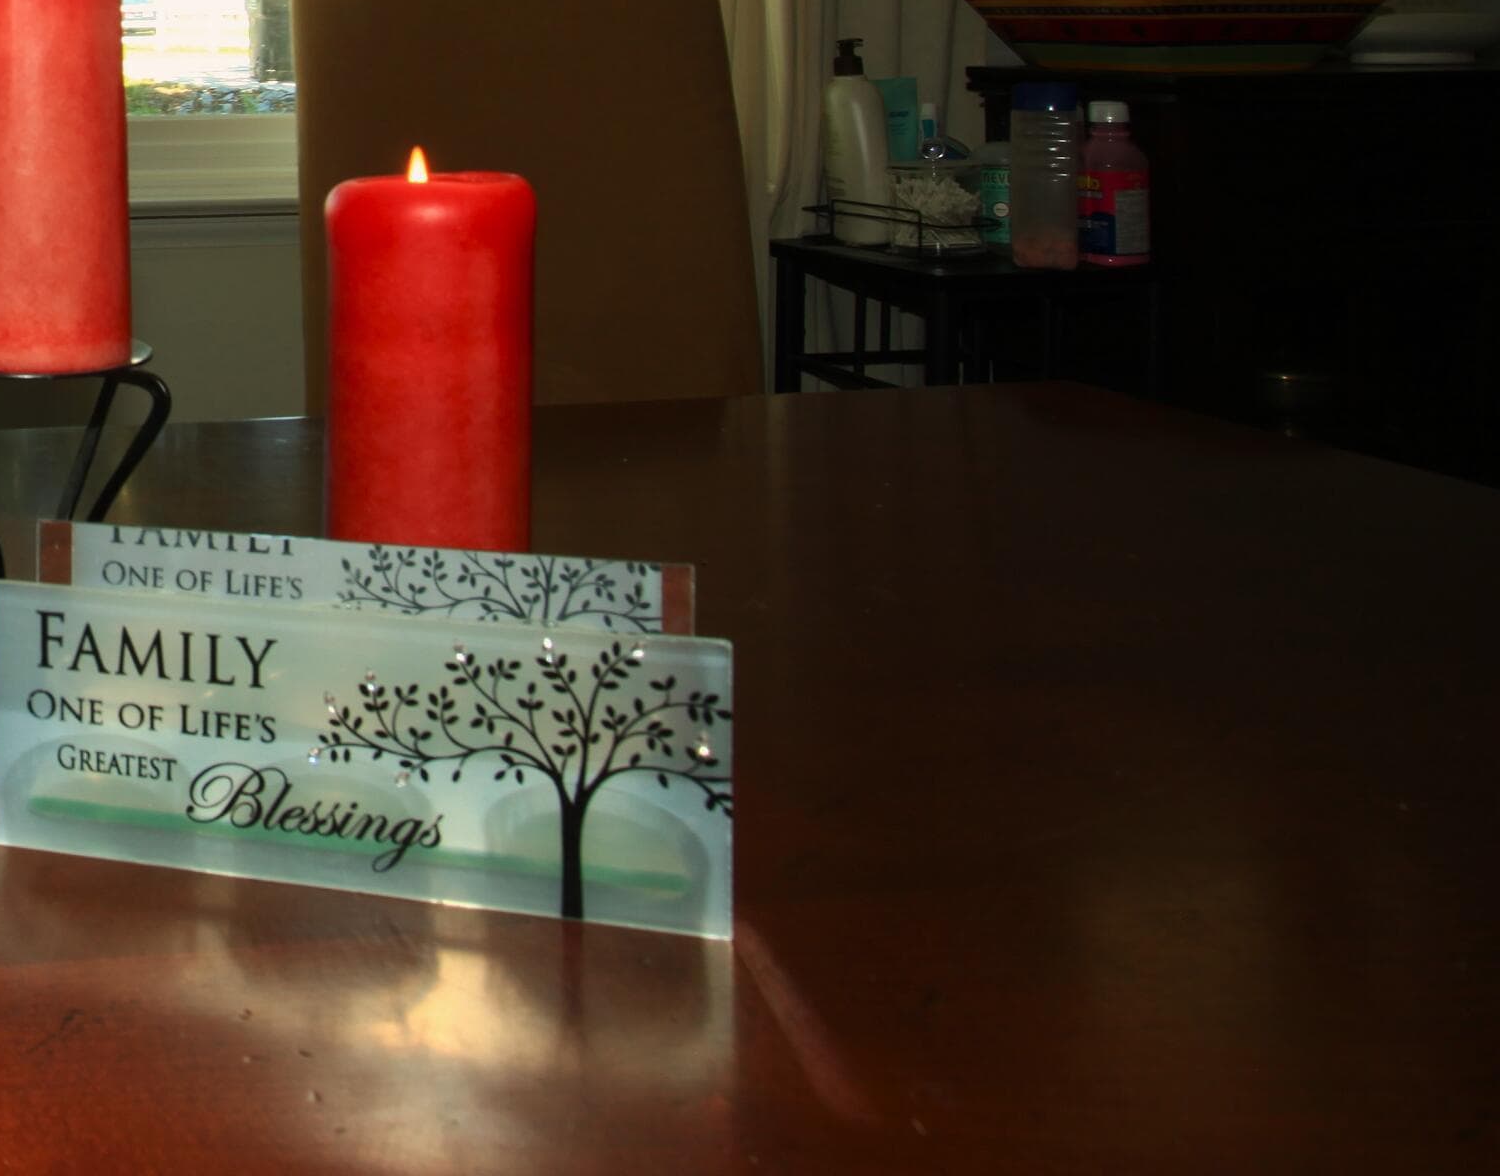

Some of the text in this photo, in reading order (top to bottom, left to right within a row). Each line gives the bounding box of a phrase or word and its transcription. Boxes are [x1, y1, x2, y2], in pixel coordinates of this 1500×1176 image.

[102, 560, 303, 599] ONE OF LIFE'S
[36, 610, 277, 688] FAMILY
[27, 689, 276, 743] ONE OF LIFE'S
[57, 744, 177, 781] GREATEST
[186, 762, 444, 872] Blessings
